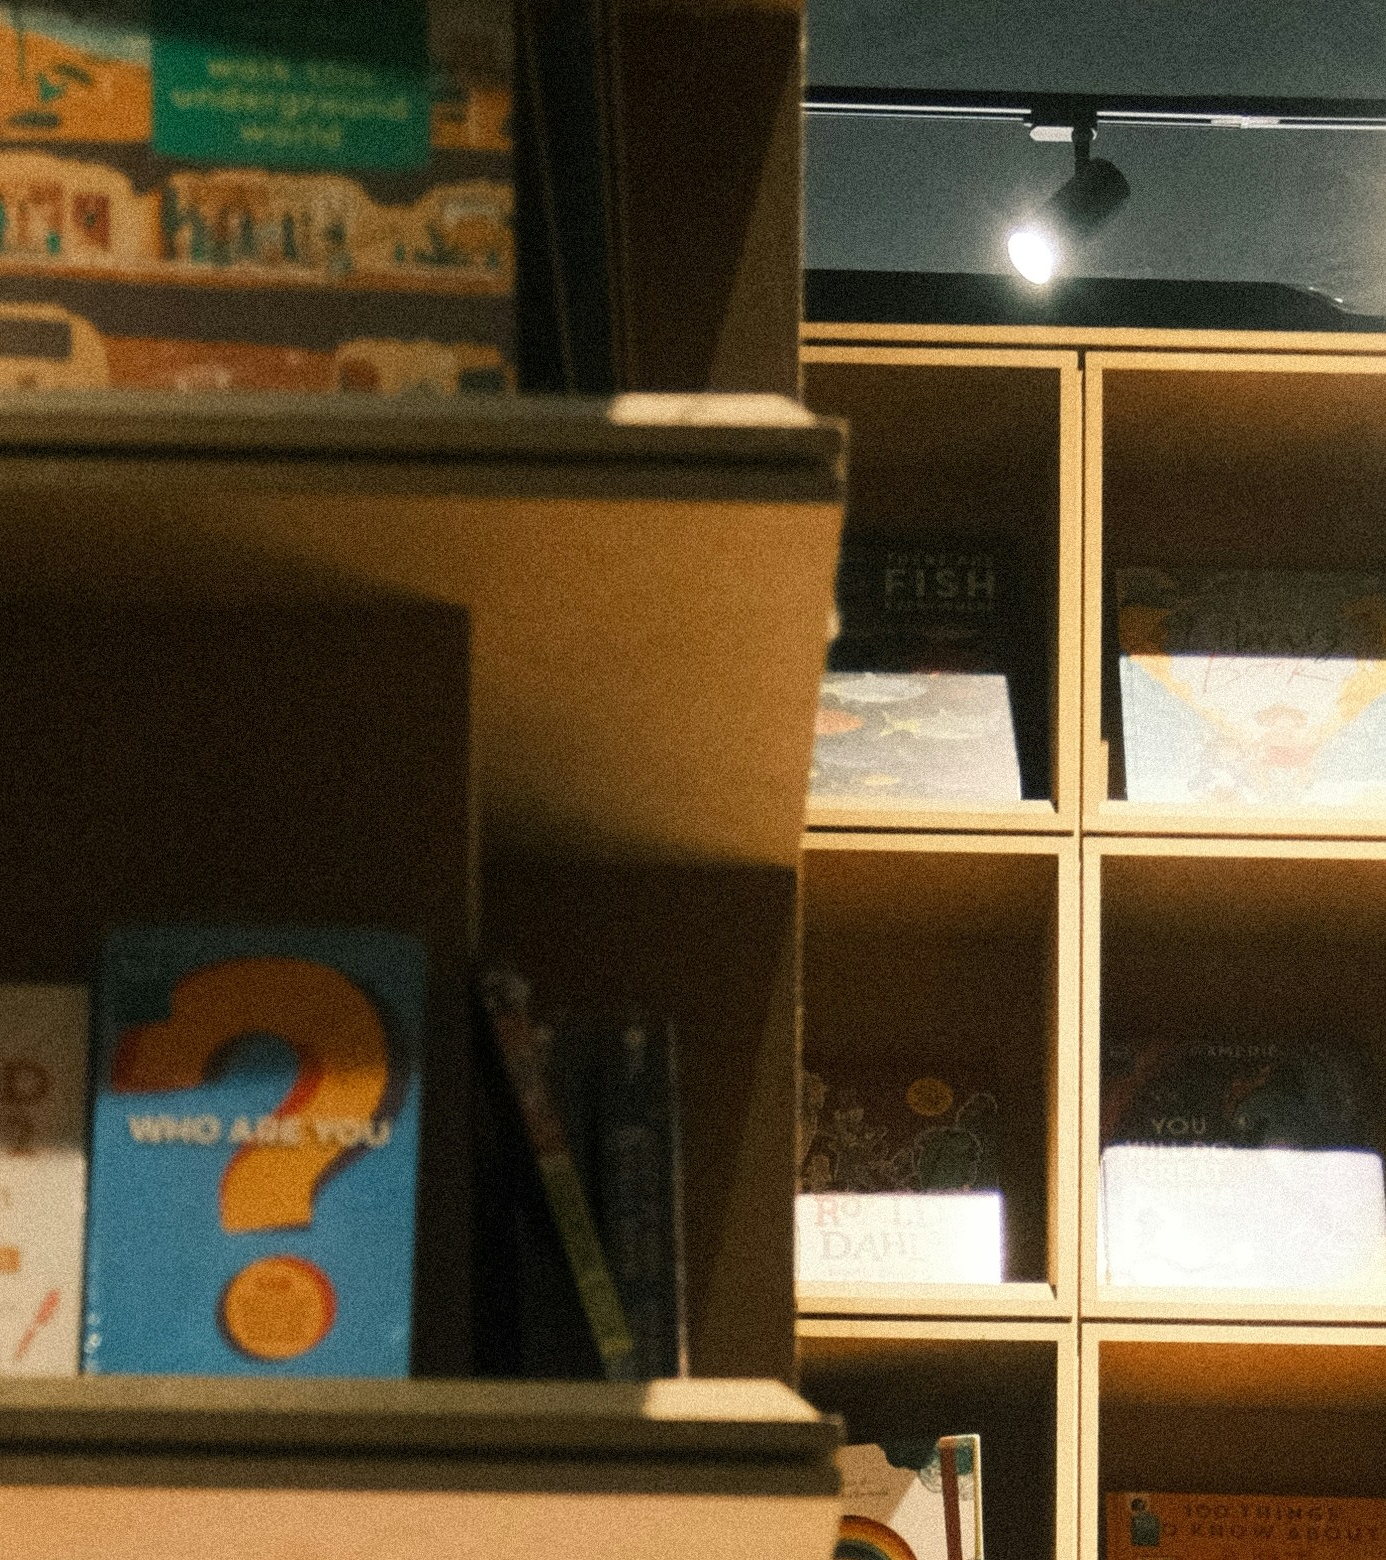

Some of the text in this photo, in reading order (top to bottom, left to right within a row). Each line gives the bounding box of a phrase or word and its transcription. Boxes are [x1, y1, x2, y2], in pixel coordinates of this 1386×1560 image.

[885, 567, 996, 598] FISH
[126, 1112, 393, 1149] WHO ARE YOU
[1150, 1115, 1209, 1137] YOU
[1184, 1502, 1337, 1523] 100 THINGS
[1190, 1521, 1275, 1541] KNOW
[1286, 1521, 1381, 1543] ABOUT
